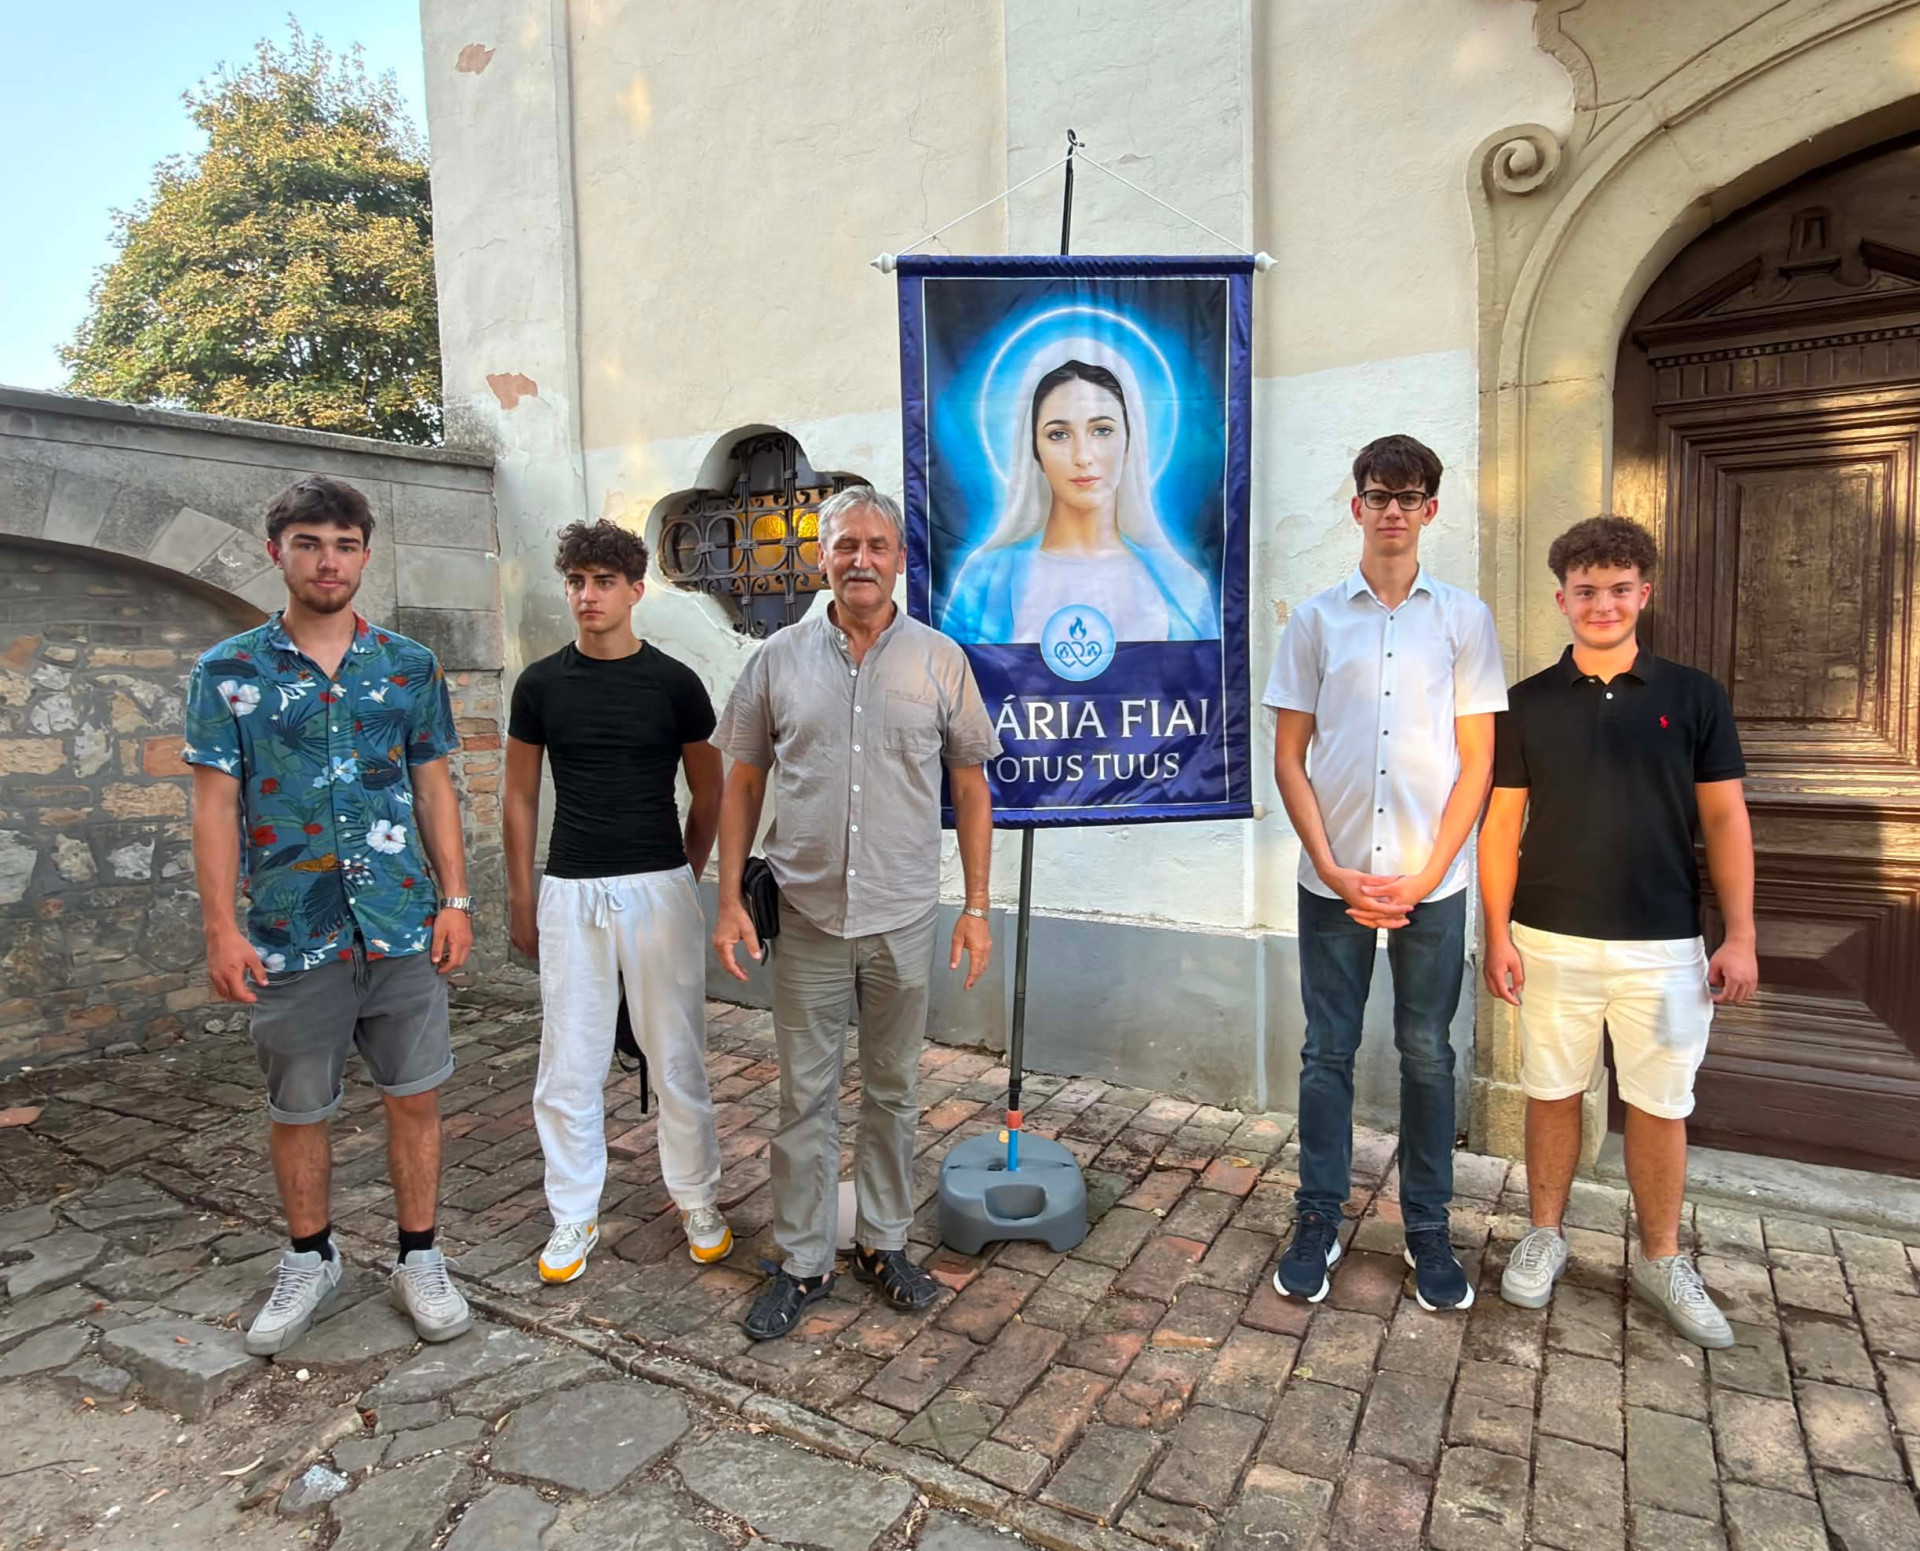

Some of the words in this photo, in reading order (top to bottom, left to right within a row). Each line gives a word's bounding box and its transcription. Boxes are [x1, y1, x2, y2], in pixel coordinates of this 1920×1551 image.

[984, 694, 1107, 741] ÁRIA
[1120, 698, 1209, 738] FIAI
[1092, 752, 1180, 781] TUUS
